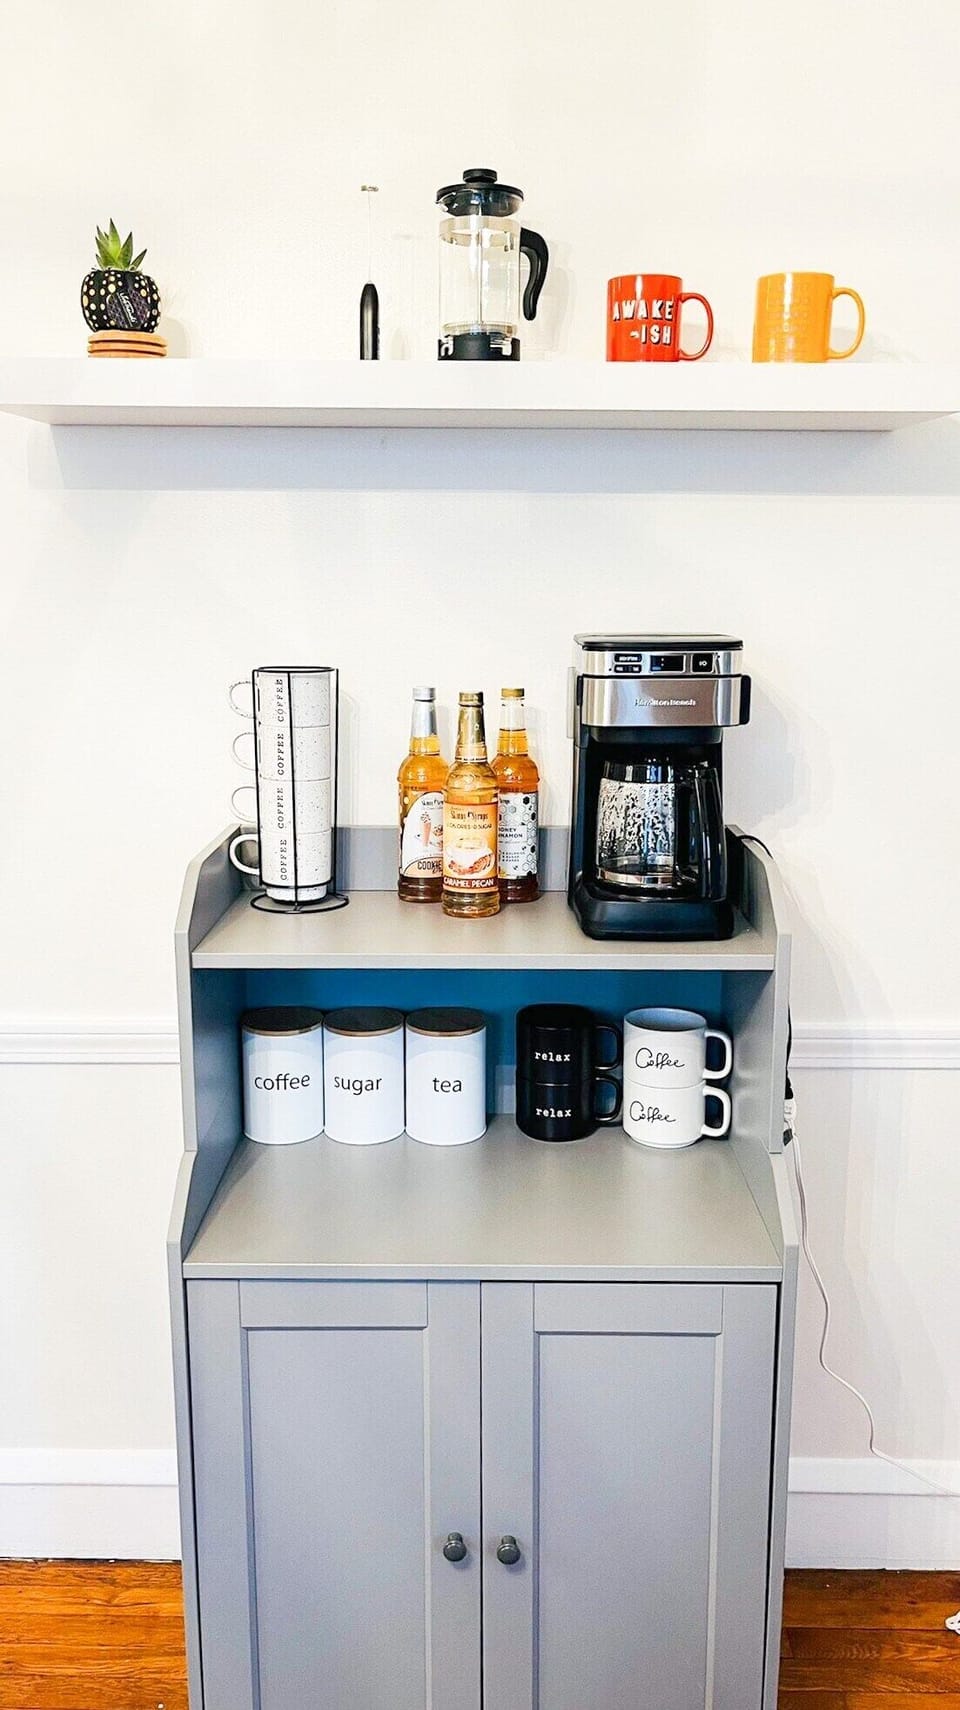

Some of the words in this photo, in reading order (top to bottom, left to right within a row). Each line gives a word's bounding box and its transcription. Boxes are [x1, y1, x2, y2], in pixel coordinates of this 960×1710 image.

[612, 298, 674, 321] AWAKE
[276, 678, 284, 722] COFFEE
[277, 733, 285, 776] COFFEE
[277, 787, 285, 829] COFFEE
[280, 838, 288, 881] COFFEE
[443, 877, 471, 888] CARAMEL
[471, 878, 495, 888] PECAN
[534, 1051, 571, 1062] relax
[635, 1046, 685, 1071] Coffee
[254, 1072, 311, 1091] coffee
[333, 1075, 383, 1096] sugar
[432, 1077, 463, 1094] tea
[535, 1107, 572, 1118] relax
[629, 1100, 677, 1124] Coffee
